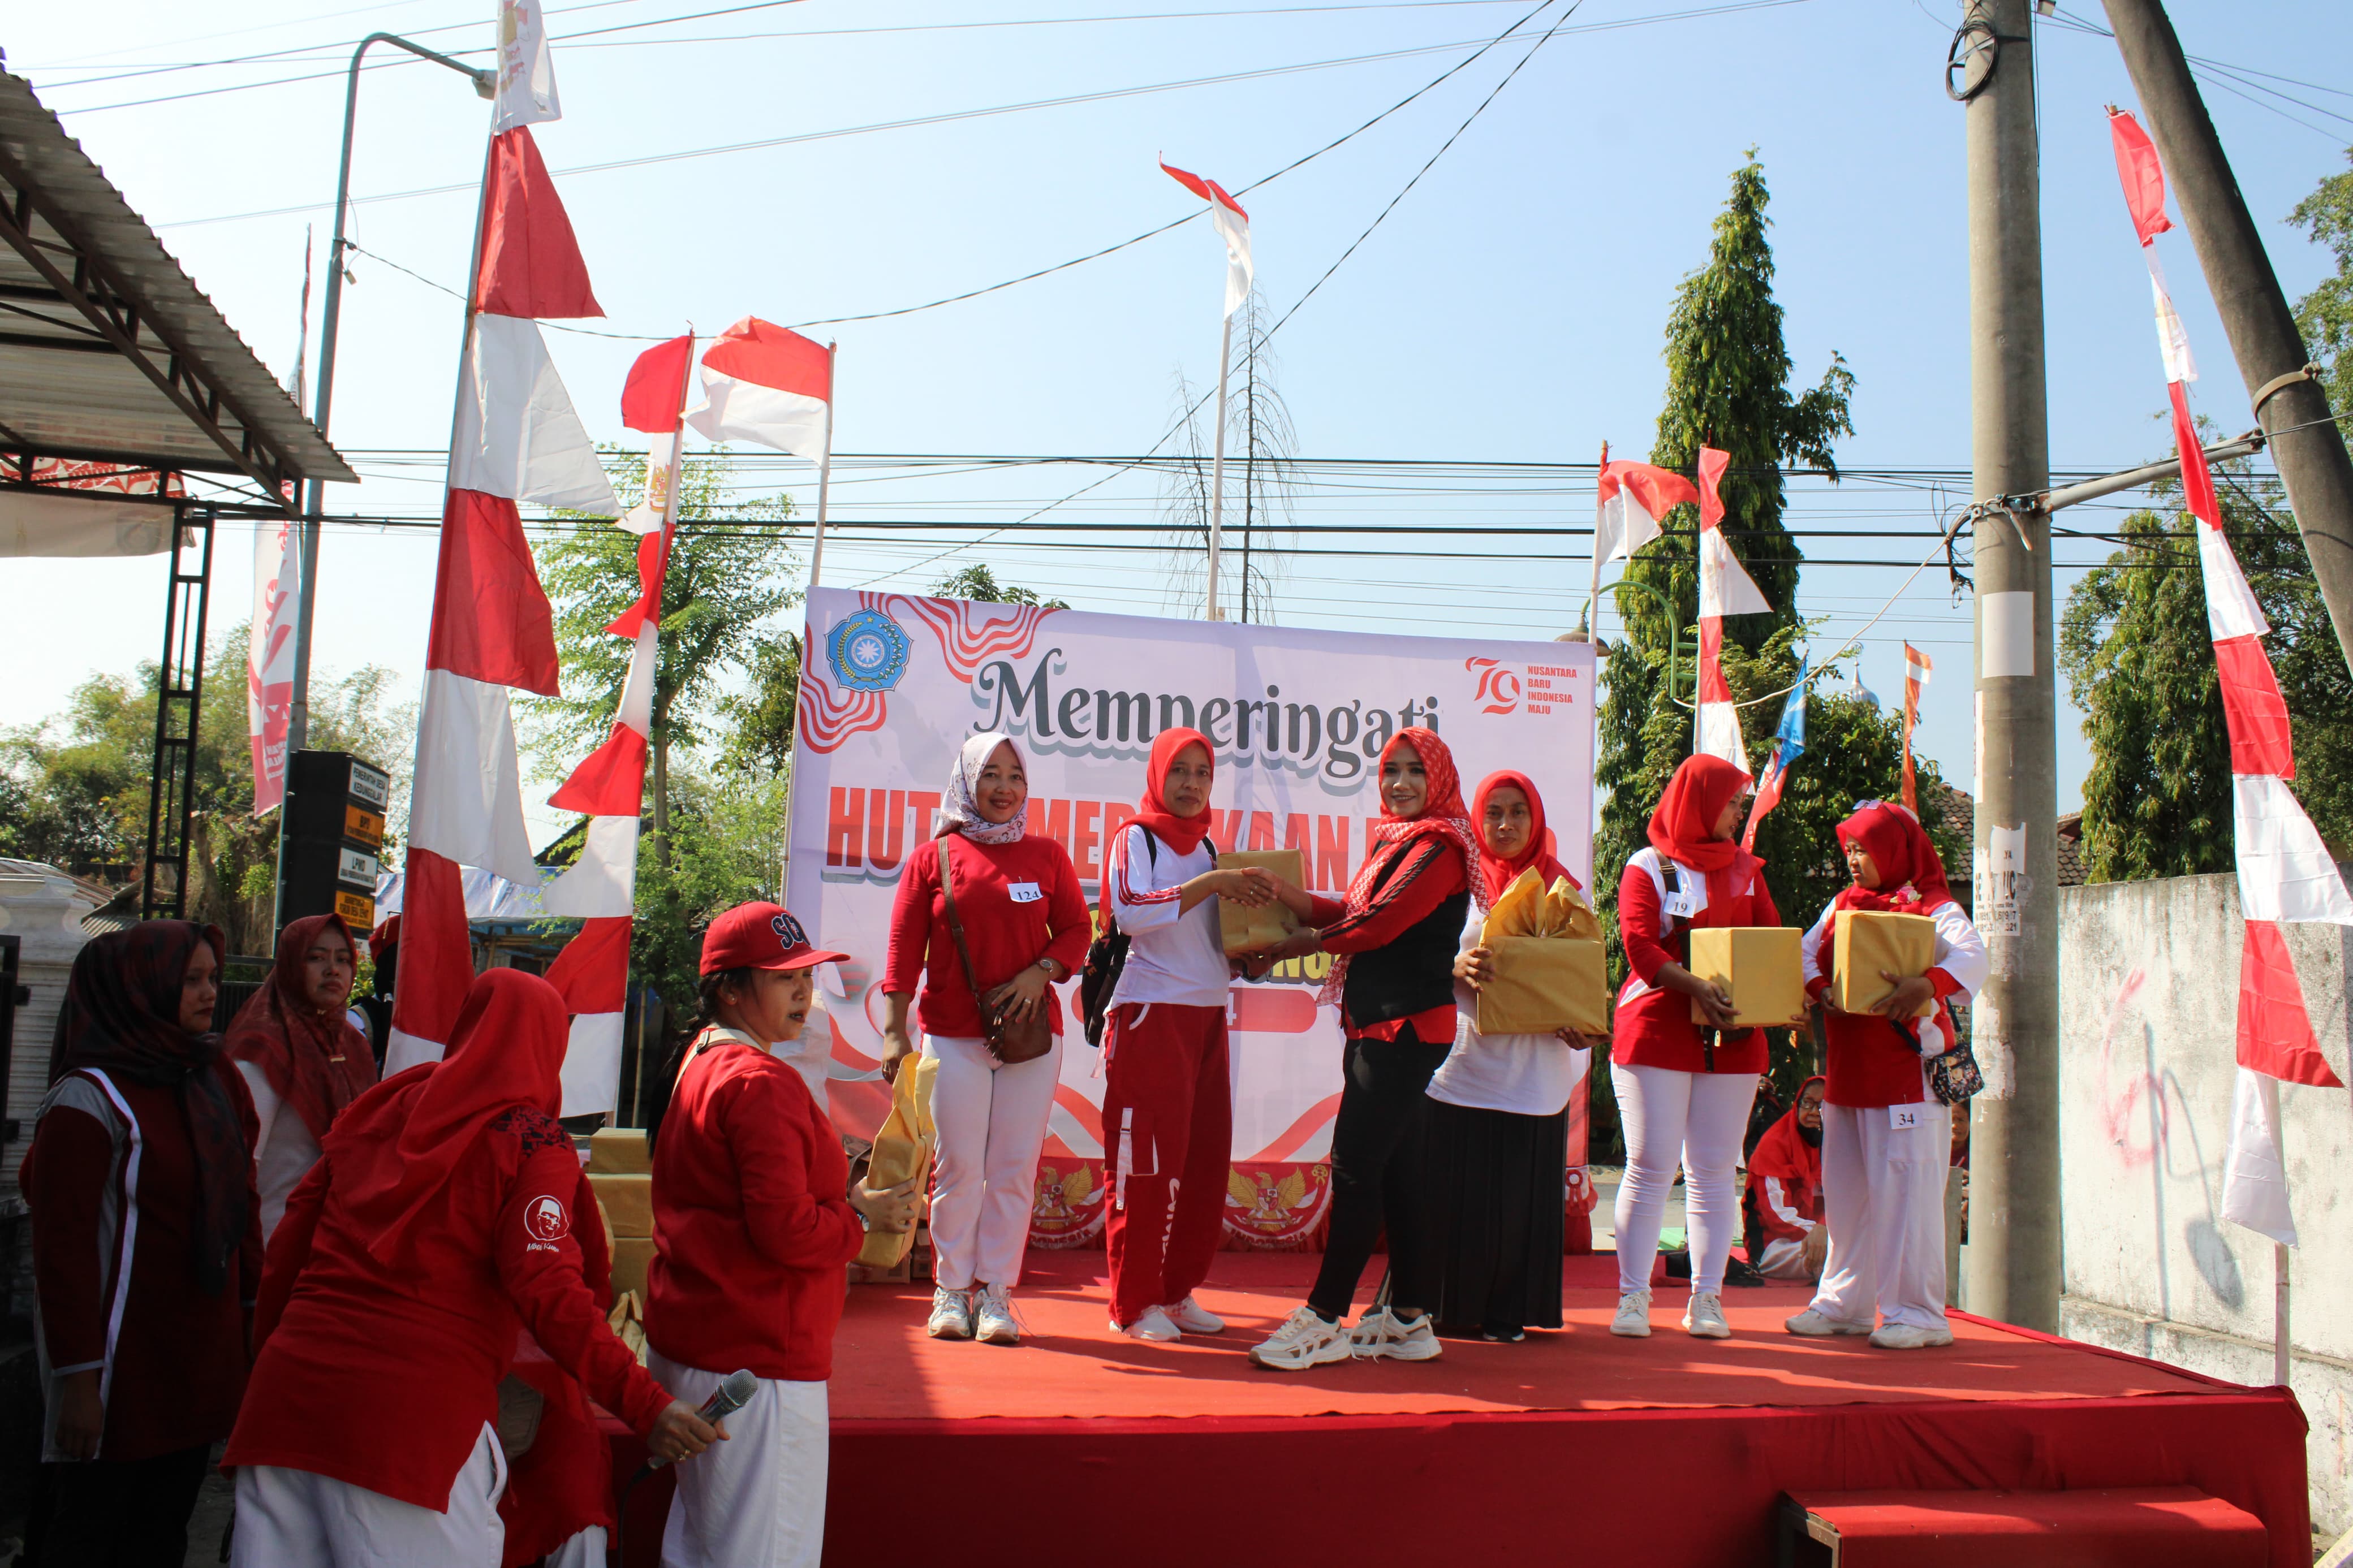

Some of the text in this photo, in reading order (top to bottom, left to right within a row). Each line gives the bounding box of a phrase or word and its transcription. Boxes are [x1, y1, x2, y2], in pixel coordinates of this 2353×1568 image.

[1527, 666, 1578, 678] NUSANTARA
[1527, 679, 1551, 689] BARU
[1527, 691, 1573, 703] INDONESIA
[973, 647, 1439, 778] Memperingati
[1527, 704, 1551, 714] MAJU
[826, 786, 941, 871] HUT
[1016, 891, 1040, 900] 124
[1674, 902, 1688, 913] 19
[1899, 1113, 1915, 1125] 34
